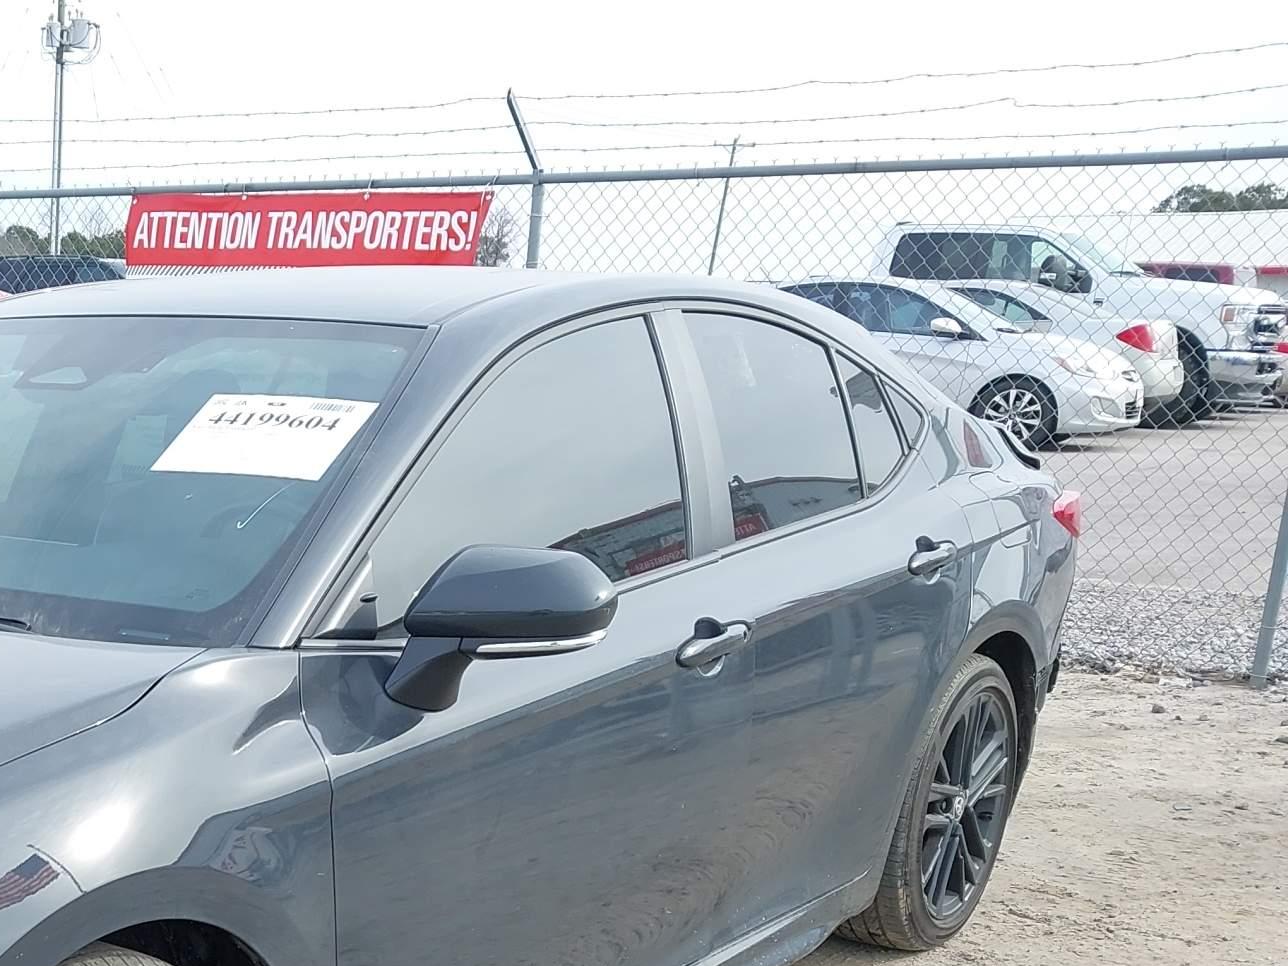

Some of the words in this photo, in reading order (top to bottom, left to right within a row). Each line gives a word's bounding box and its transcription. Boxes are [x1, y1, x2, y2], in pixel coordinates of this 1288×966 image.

[133, 211, 261, 250] ATTENTION
[266, 210, 478, 252] TRANSPORTERS!
[208, 411, 342, 431] 44199604
